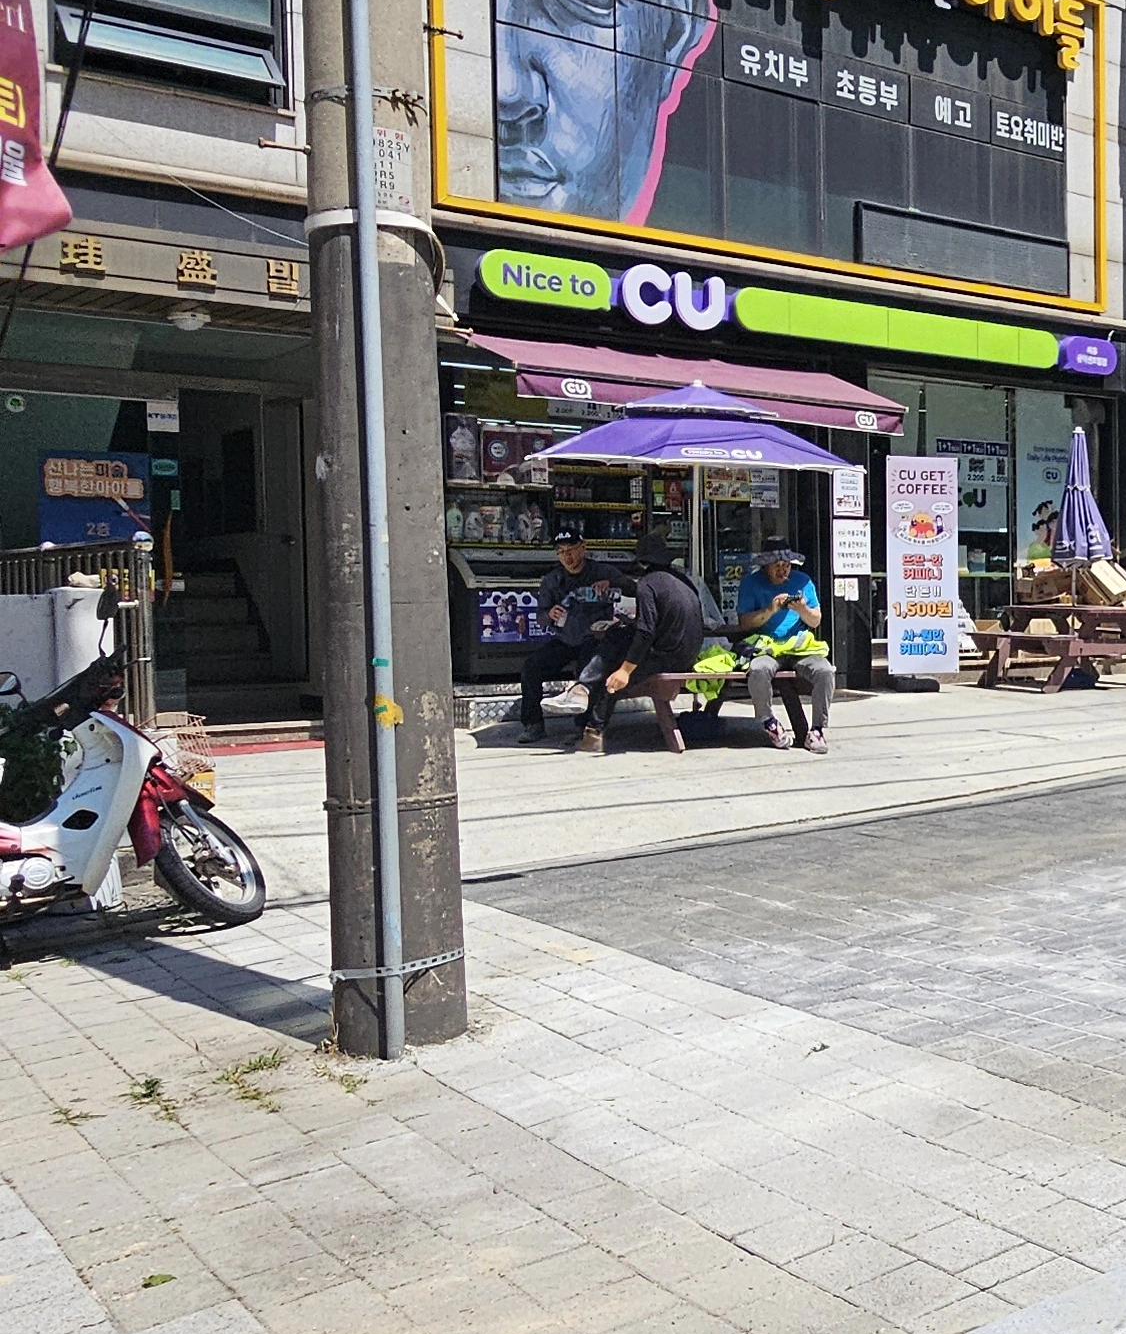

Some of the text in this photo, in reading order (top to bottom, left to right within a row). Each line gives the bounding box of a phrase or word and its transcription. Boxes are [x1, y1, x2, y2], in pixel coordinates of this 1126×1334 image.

[740, 44, 1064, 152] 유치부 초등부 예고 토요취미반
[502, 262, 727, 331] Nice to CU
[566, 381, 586, 395] CU
[730, 449, 762, 461] CU
[899, 470, 946, 481] CU GET
[897, 483, 948, 495] COFFEE
[892, 601, 954, 619] 1,500원
